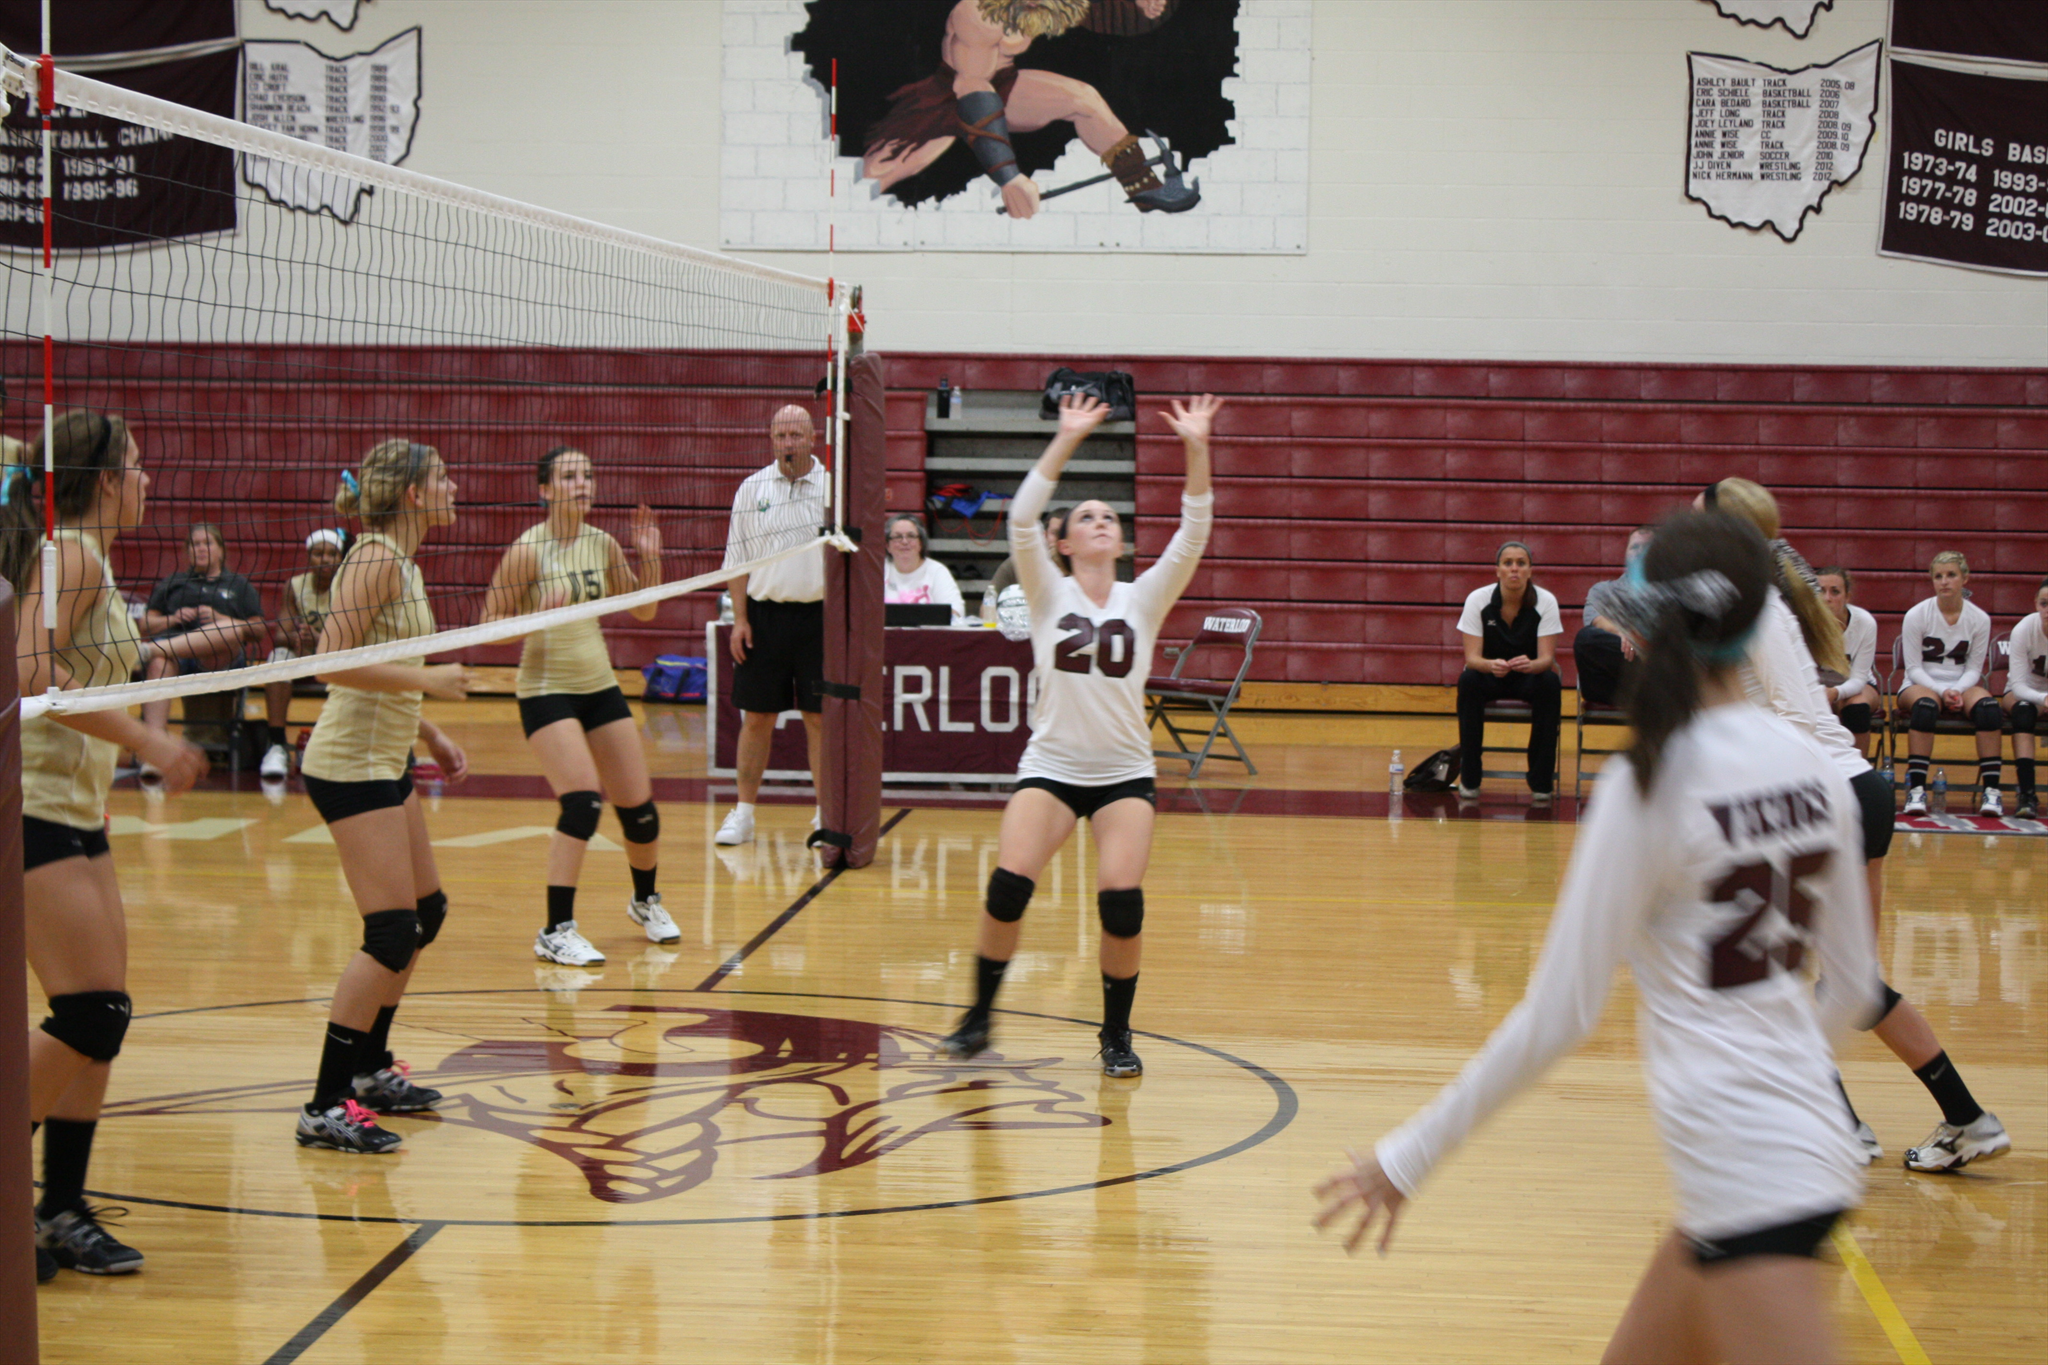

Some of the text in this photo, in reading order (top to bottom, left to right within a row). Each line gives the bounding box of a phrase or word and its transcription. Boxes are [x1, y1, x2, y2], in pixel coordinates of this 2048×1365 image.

[325, 64, 347, 73] TRACK
[325, 74, 347, 83] TRACK
[1697, 78, 1726, 87] ASHLEY
[1763, 78, 1787, 88] TRACK
[325, 85, 347, 94] TRACK
[1696, 88, 1714, 97] ERIC
[1762, 89, 1812, 98] BASKETBALL
[1820, 89, 1840, 99] 2006
[325, 95, 347, 104] TRACK
[1695, 98, 1839, 109] CARA BEDARD BASKETBALL 2007
[325, 105, 347, 113] TRACK
[1695, 108, 1839, 119] JEFF LONG TRACK 2008
[325, 125, 347, 133] TRACK
[1695, 119, 1715, 128] JOEY
[1719, 119, 1754, 128] LEYLAND
[1762, 120, 1785, 129] TRACK
[1694, 129, 1717, 139] ANNIE
[1722, 129, 1739, 139] WISE
[1761, 130, 1771, 139] CC
[1841, 132, 1849, 141] 10
[1694, 140, 1715, 149] ANNIE
[1721, 140, 1738, 149] WISE
[1761, 141, 1784, 149] TRACK
[1934, 128, 2048, 165] GIRLS BAS
[1693, 150, 1714, 159] JOHN
[1760, 151, 1790, 160] SOCCER
[1816, 151, 1833, 160] 2010
[1708, 160, 1732, 170] DIVEN
[1759, 161, 1801, 171] WRESTLING
[1815, 161, 1834, 171] 2012
[1692, 171, 1833, 181] NICK HERMANN WRESTLING 2012
[1903, 151, 2048, 193] 1973-74 1993-
[1901, 175, 2048, 219] 1977-78 2002-
[1899, 201, 1974, 231] 1978-79
[1053, 612, 1135, 678] 20
[1921, 636, 1970, 665] 24
